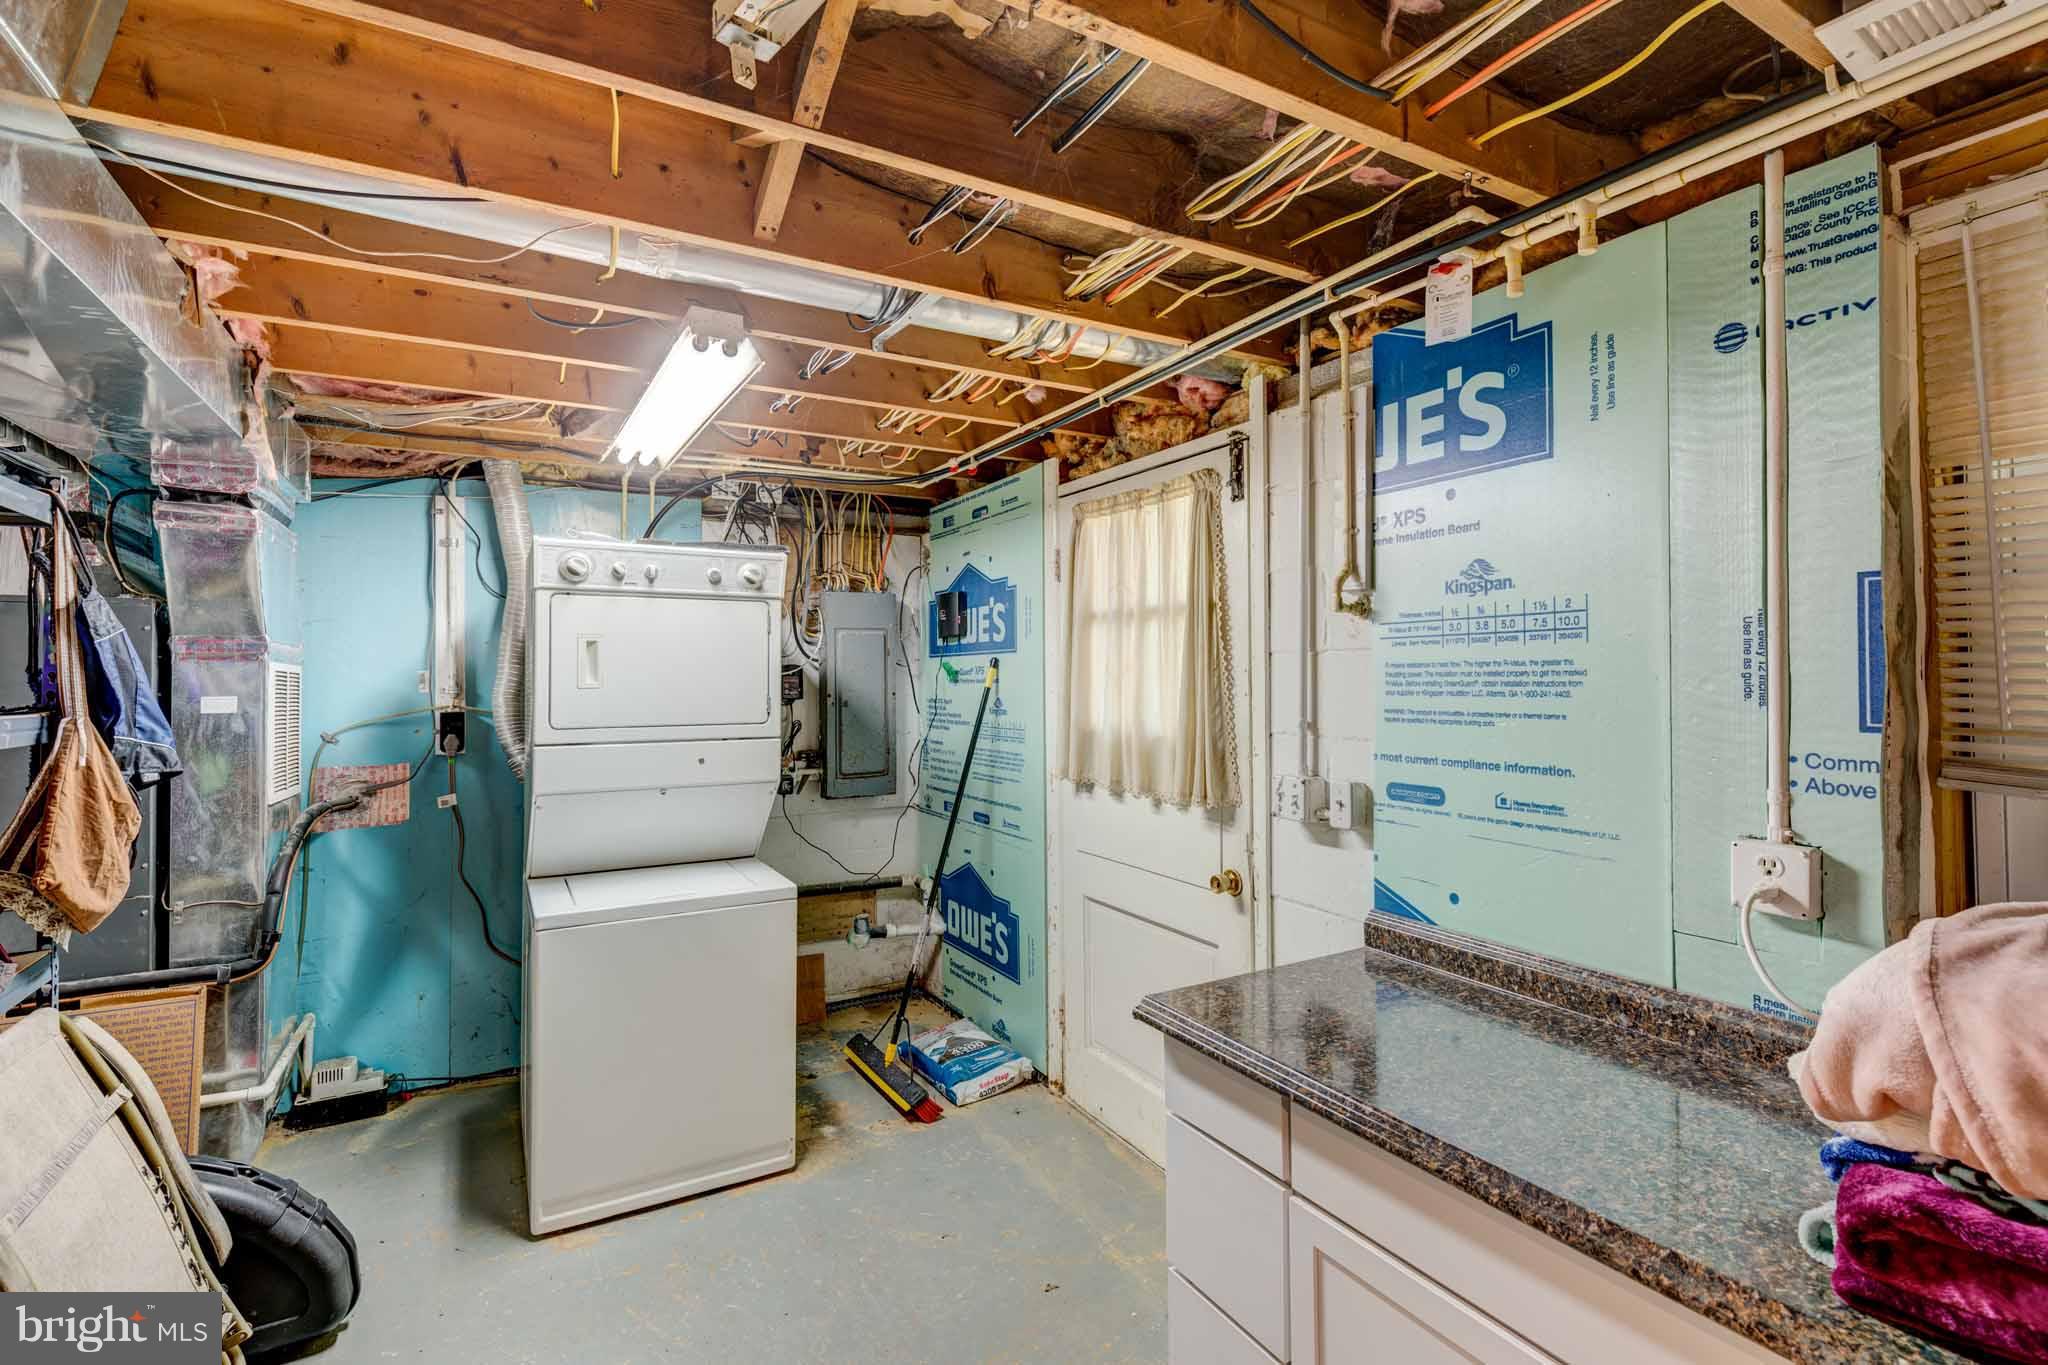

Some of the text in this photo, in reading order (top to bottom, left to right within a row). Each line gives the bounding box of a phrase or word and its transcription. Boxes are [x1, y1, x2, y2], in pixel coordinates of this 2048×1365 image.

[1797, 180, 1853, 205] resistance
[1855, 175, 1866, 184] to
[1785, 196, 1831, 217] installing
[1818, 211, 1840, 223] See
[1814, 215, 1853, 234] County
[1809, 256, 1832, 269] This
[1835, 242, 1877, 264] product
[1589, 364, 1598, 377] 12
[1607, 360, 1615, 372] as
[1393, 507, 1426, 528] XPS
[1396, 528, 1445, 544] Insulation
[1448, 520, 1481, 535] Board
[1564, 598, 1573, 609] 2
[1501, 618, 1516, 630] 5.0
[1532, 617, 1548, 628] 7.5
[1558, 615, 1580, 627] 10.0
[1741, 616, 1754, 702] Use line as guide.
[1380, 753, 1576, 779] most current compliance information.
[1805, 777, 1877, 799] Above
